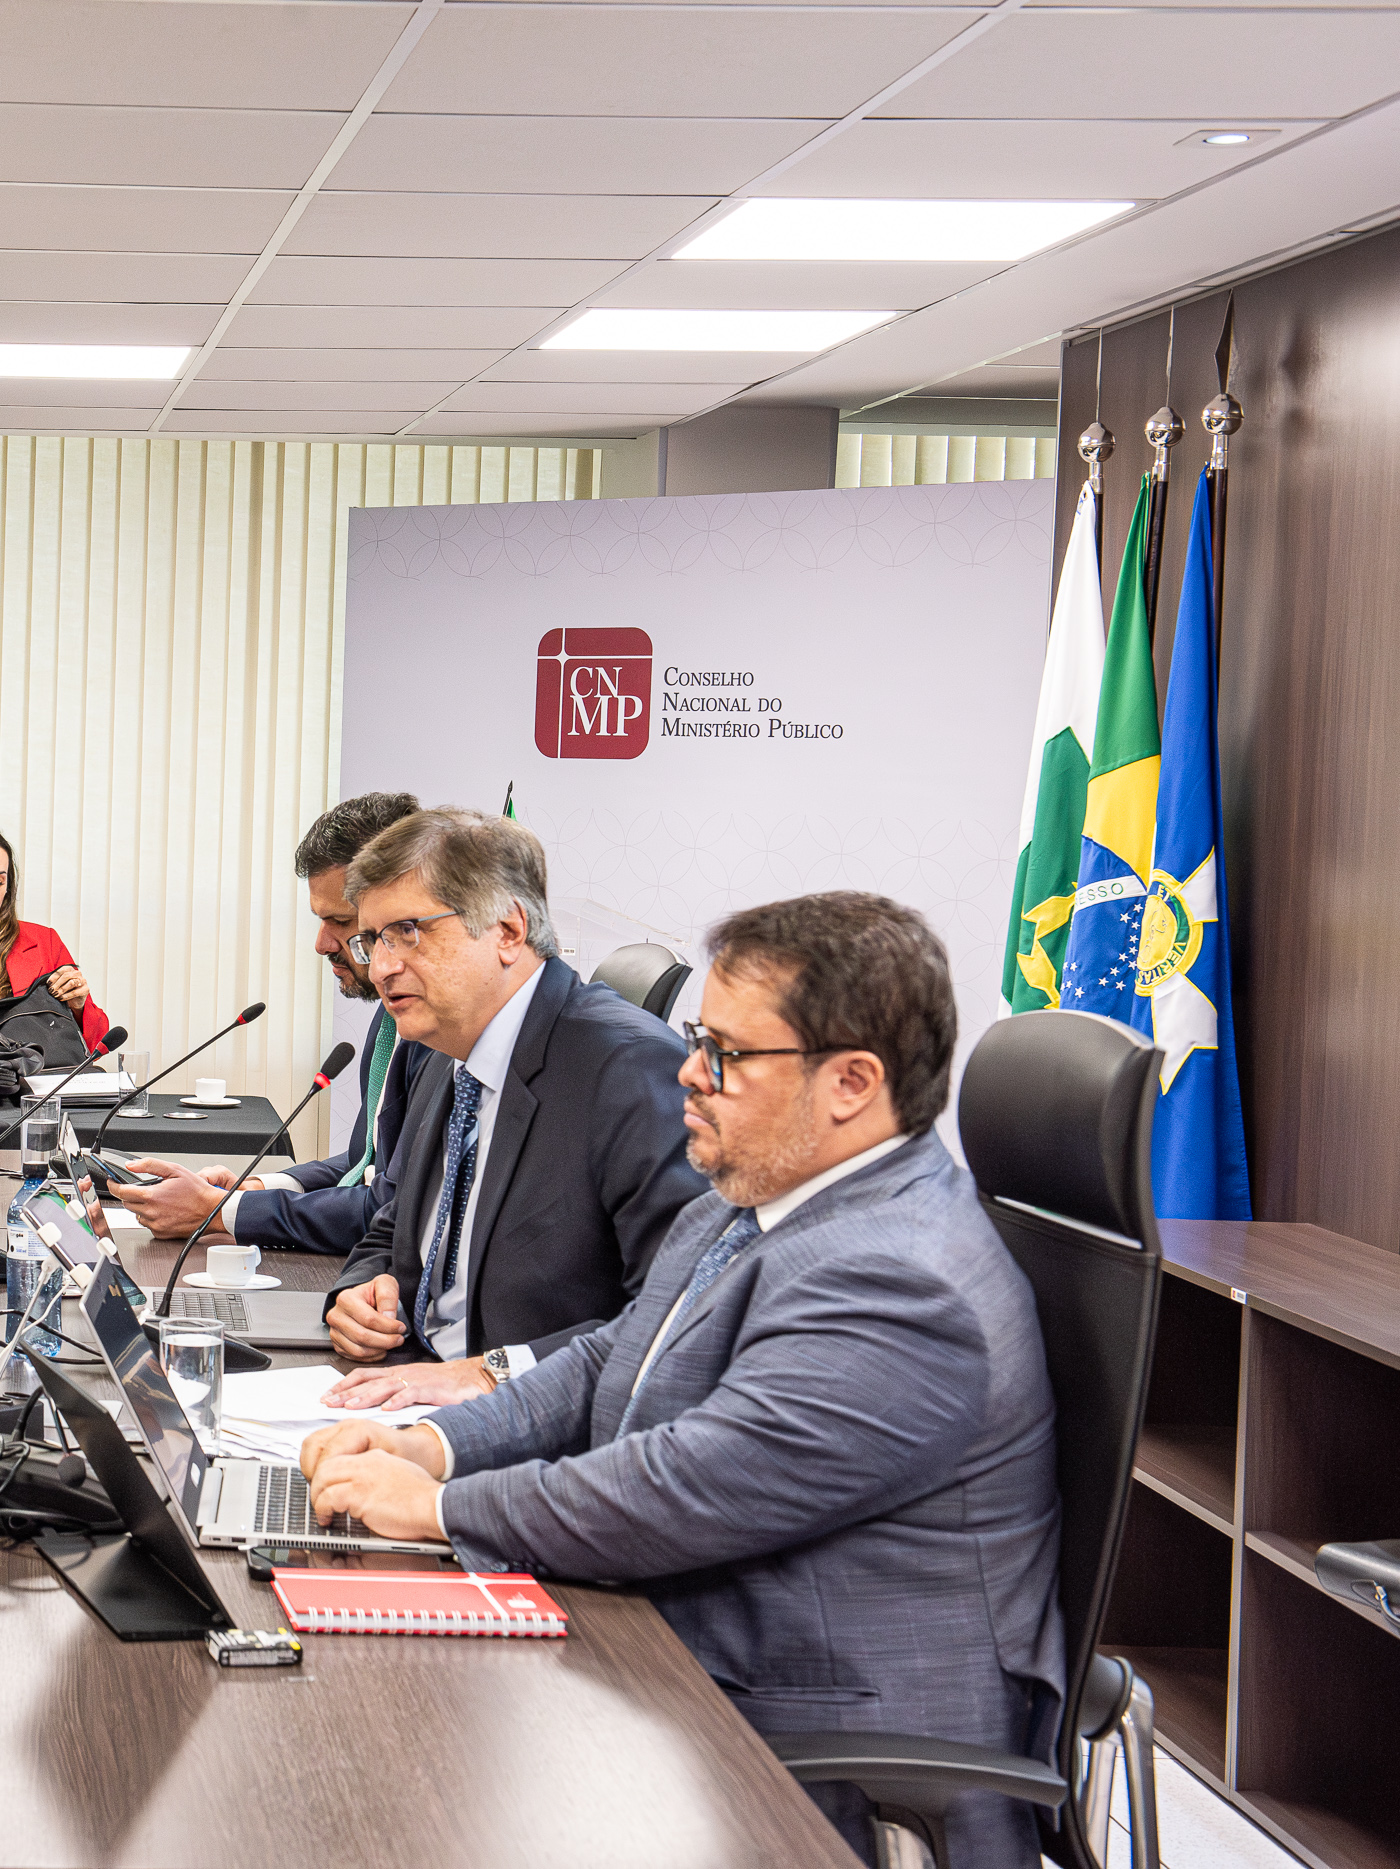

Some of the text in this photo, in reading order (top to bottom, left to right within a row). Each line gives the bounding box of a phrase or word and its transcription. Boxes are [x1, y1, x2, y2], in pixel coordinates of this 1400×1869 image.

[569, 666, 623, 698] CN
[567, 695, 643, 736] MP
[757, 697, 782, 713] DO
